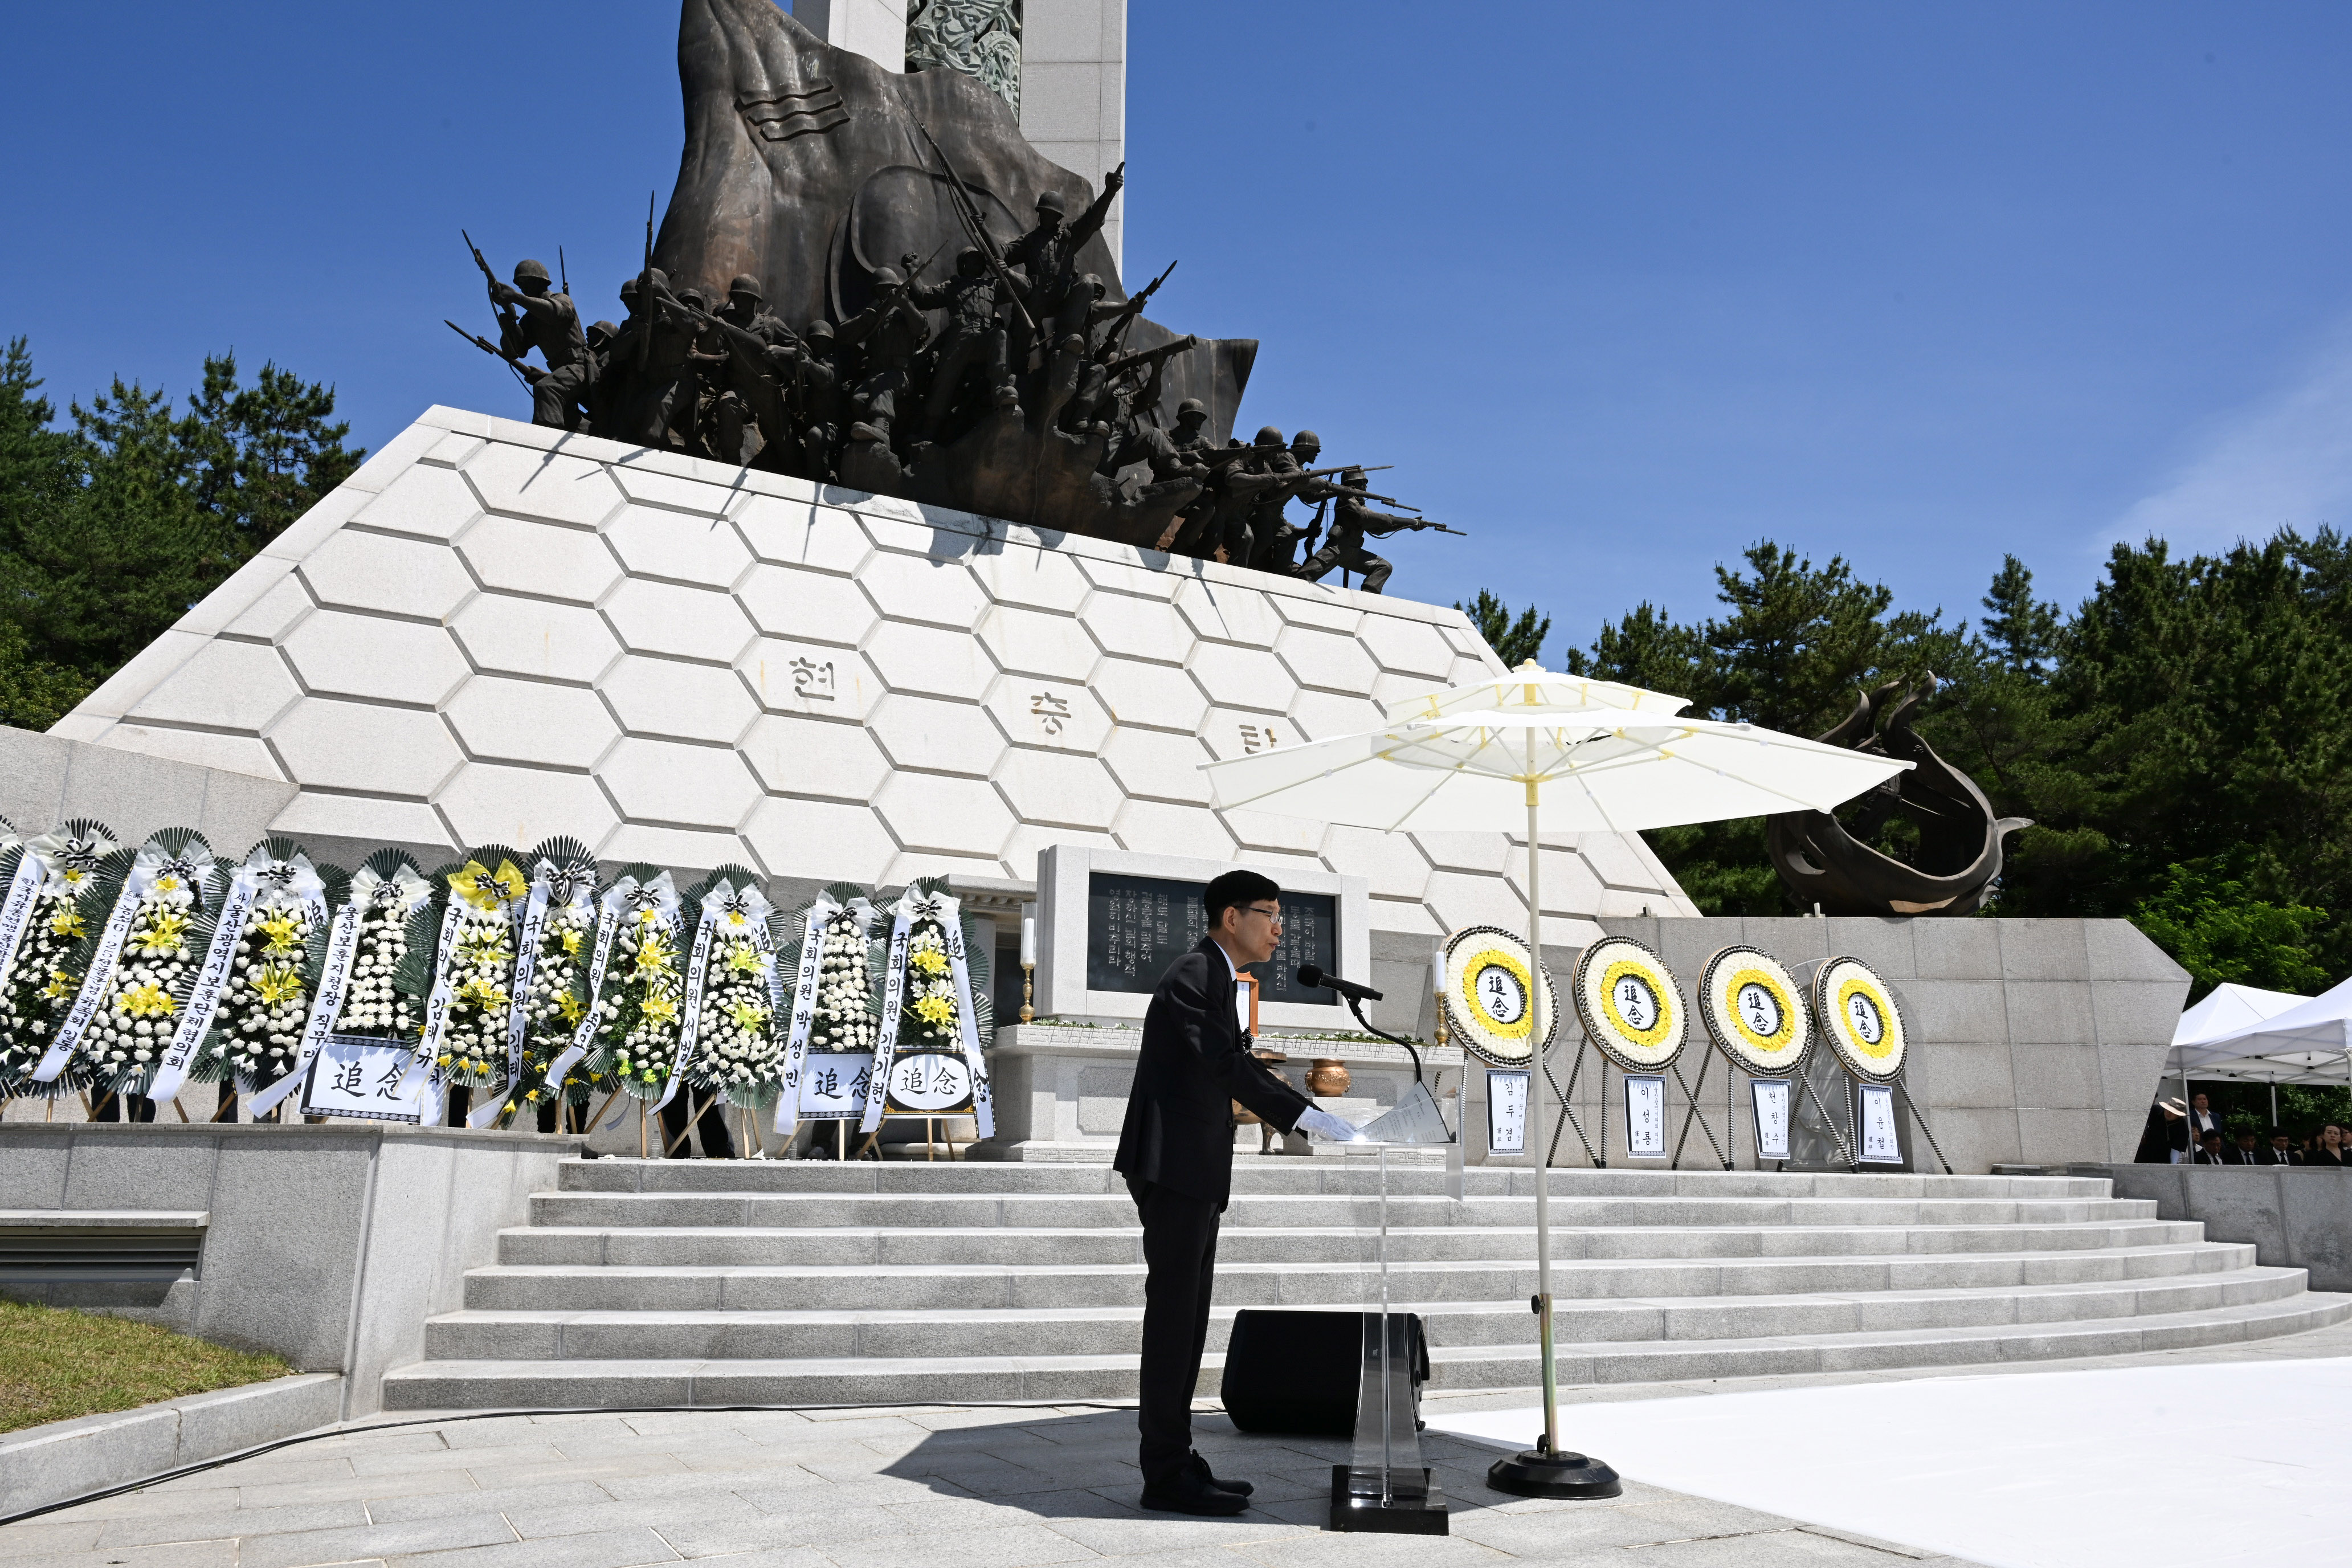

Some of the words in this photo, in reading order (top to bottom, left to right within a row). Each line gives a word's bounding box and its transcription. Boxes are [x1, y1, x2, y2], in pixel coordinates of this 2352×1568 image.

[1109, 889, 1121, 921] 영원히
[1125, 890, 1137, 923] 장하신
[1141, 892, 1153, 928] 걸음을
[1157, 893, 1168, 916] 해도
[1304, 907, 1315, 937] 조국이
[589, 912, 616, 989] 국회의원
[753, 924, 775, 956] 追
[1108, 922, 1121, 966] 비추리라
[1125, 927, 1136, 948] 님의
[1141, 931, 1152, 962] 멈추어
[1157, 920, 1169, 944] 달도
[321, 906, 359, 1006] 울산보훈지청장
[513, 914, 541, 1013] 국회의원
[687, 920, 713, 1008] 국회의원
[799, 928, 822, 1001] 국회의원
[1124, 950, 1136, 977] 행적
[885, 932, 908, 1022] 국회의원
[1488, 976, 1509, 1018] 追念
[1624, 985, 1644, 1025] 追念
[1747, 992, 1769, 1031] 追念
[1855, 1001, 1872, 1039] 追念
[55, 1029, 78, 1052] 일동
[415, 998, 446, 1069] 김태규
[671, 1017, 695, 1085] 서범수
[785, 1010, 811, 1088] 박성민
[814, 1066, 871, 1100] 追念
[872, 1031, 893, 1104] 김기현
[900, 1067, 959, 1095] 追念
[1505, 1082, 1514, 1142] 김두겸
[1641, 1087, 1652, 1146] 이성룡
[1769, 1091, 1779, 1145] 천창수
[1874, 1097, 1884, 1150] 이윤철
